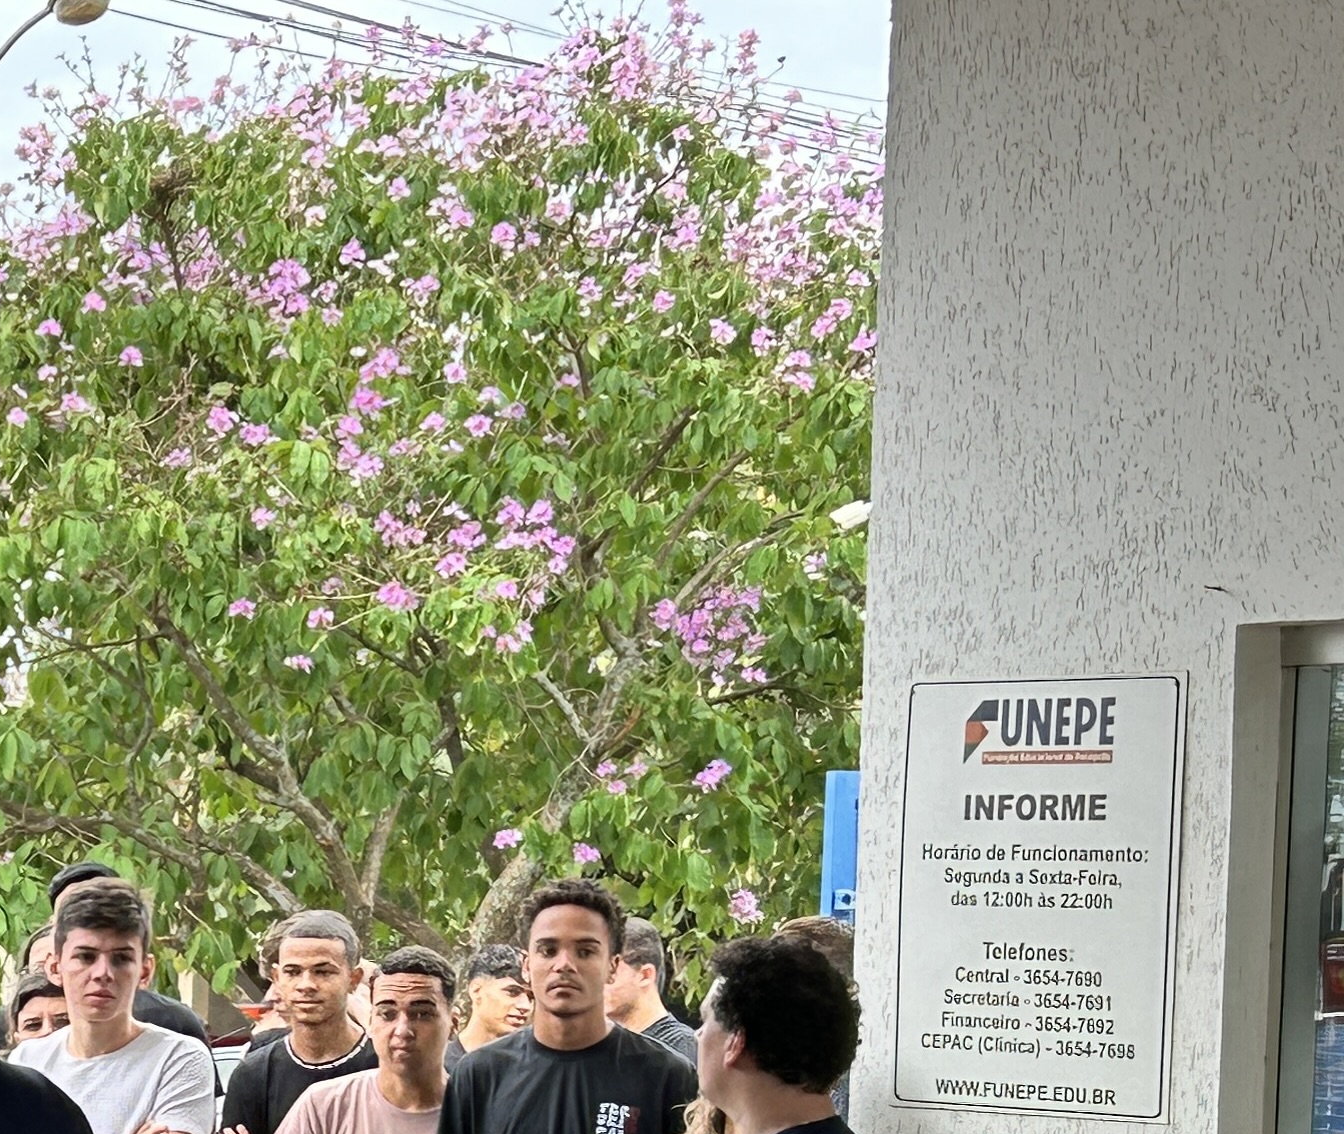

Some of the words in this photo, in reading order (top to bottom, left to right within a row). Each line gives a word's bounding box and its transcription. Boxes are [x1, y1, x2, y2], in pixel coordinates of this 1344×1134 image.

[963, 697, 1116, 764] FUNEPE
[963, 794, 1108, 821] INFORME
[922, 843, 981, 861] Horário
[986, 844, 1006, 861] de
[1011, 844, 1150, 863] Funcionamento:
[944, 868, 1010, 887] Segunda
[1015, 871, 1024, 885] a
[951, 891, 978, 906] das
[983, 891, 1033, 908] 12:00h
[1038, 892, 1055, 908] às
[1060, 893, 1113, 910] 22:00h
[983, 941, 1075, 962] Telefones:
[955, 967, 1009, 984] Central
[944, 989, 1020, 1007] Secretaria
[1034, 993, 1112, 1011] 3654-7691
[941, 1011, 1020, 1030] Financeiro
[921, 1033, 973, 1051] CEPAC
[1055, 1040, 1136, 1060] 3654-7698
[935, 1078, 1117, 1106] WWW.FUNEPE.EDU.BR
